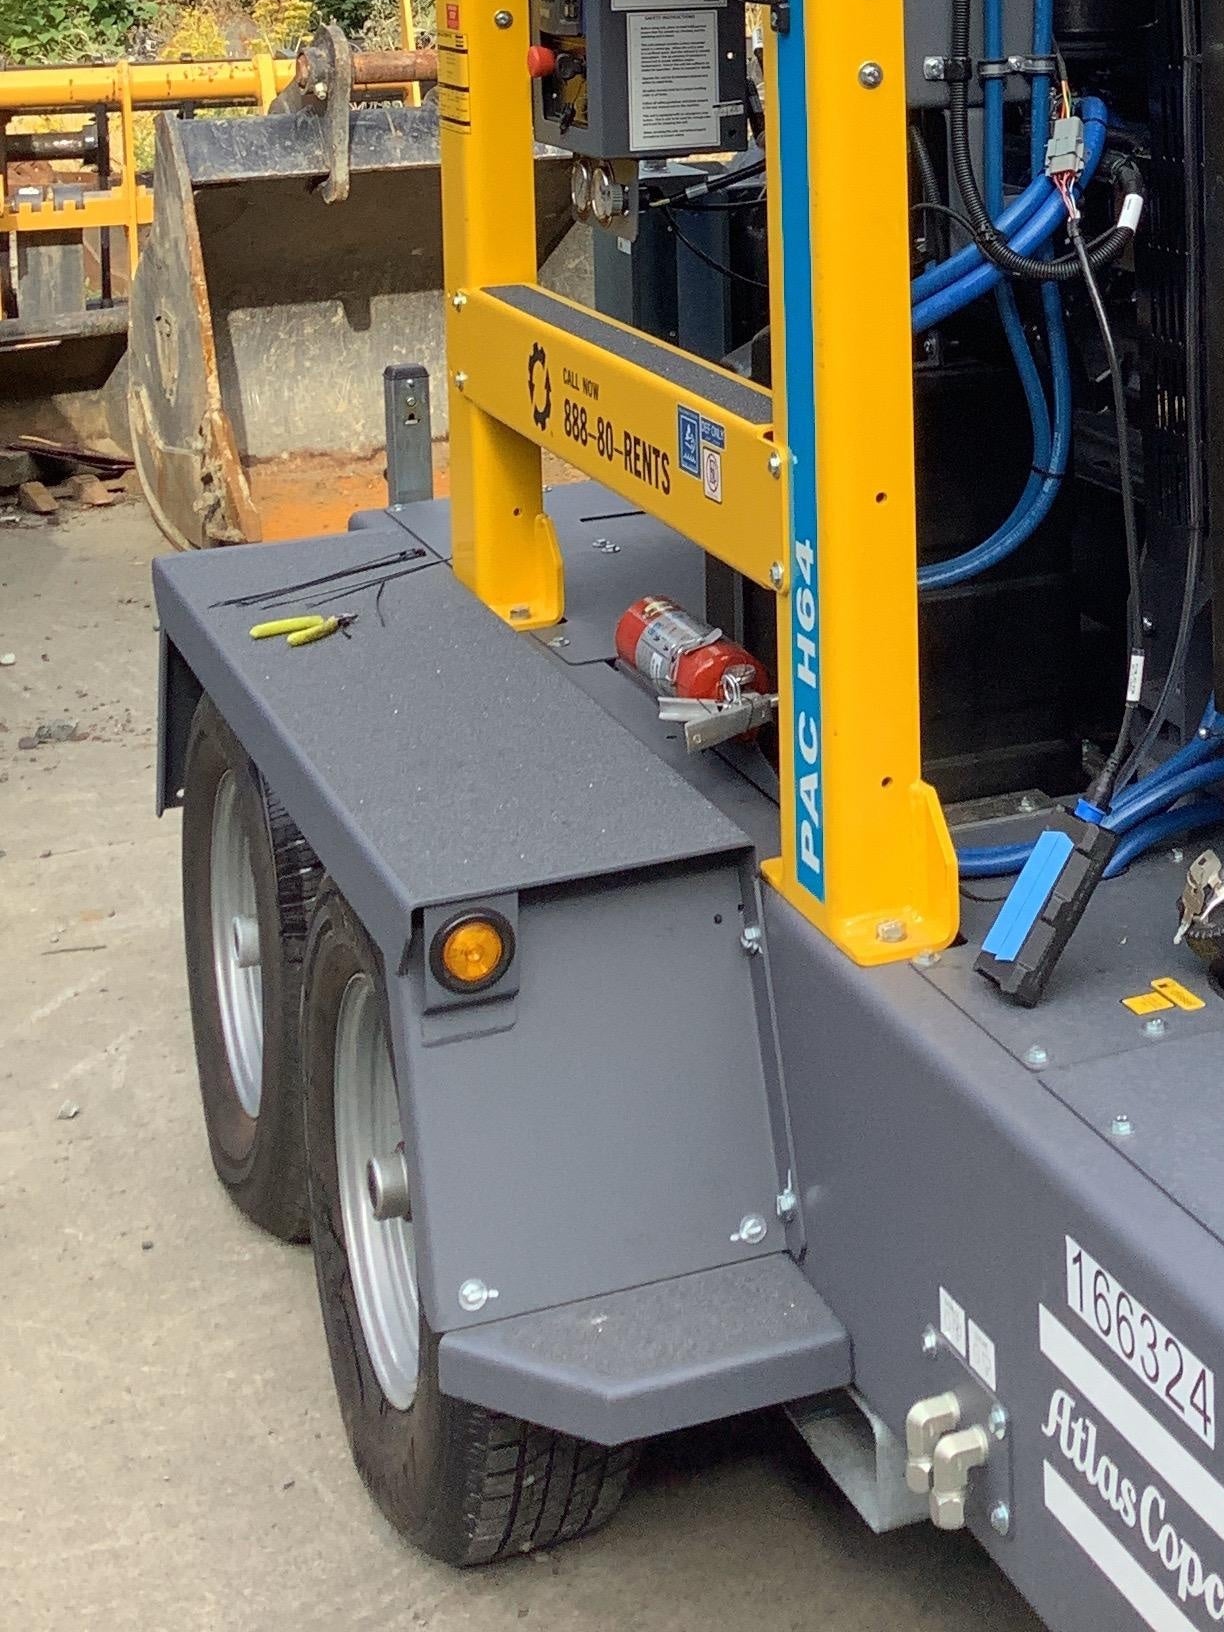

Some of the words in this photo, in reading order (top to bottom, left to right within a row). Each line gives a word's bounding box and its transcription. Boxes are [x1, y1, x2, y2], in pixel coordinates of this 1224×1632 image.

[563, 369, 579, 391] CALL
[583, 379, 599, 400] NOW
[564, 399, 670, 495] 888-80-RENTS
[795, 539, 817, 689] H64
[797, 711, 821, 874] PAC
[1071, 1249, 1212, 1437] 166324
[1040, 1388, 1137, 1530] Atlas
